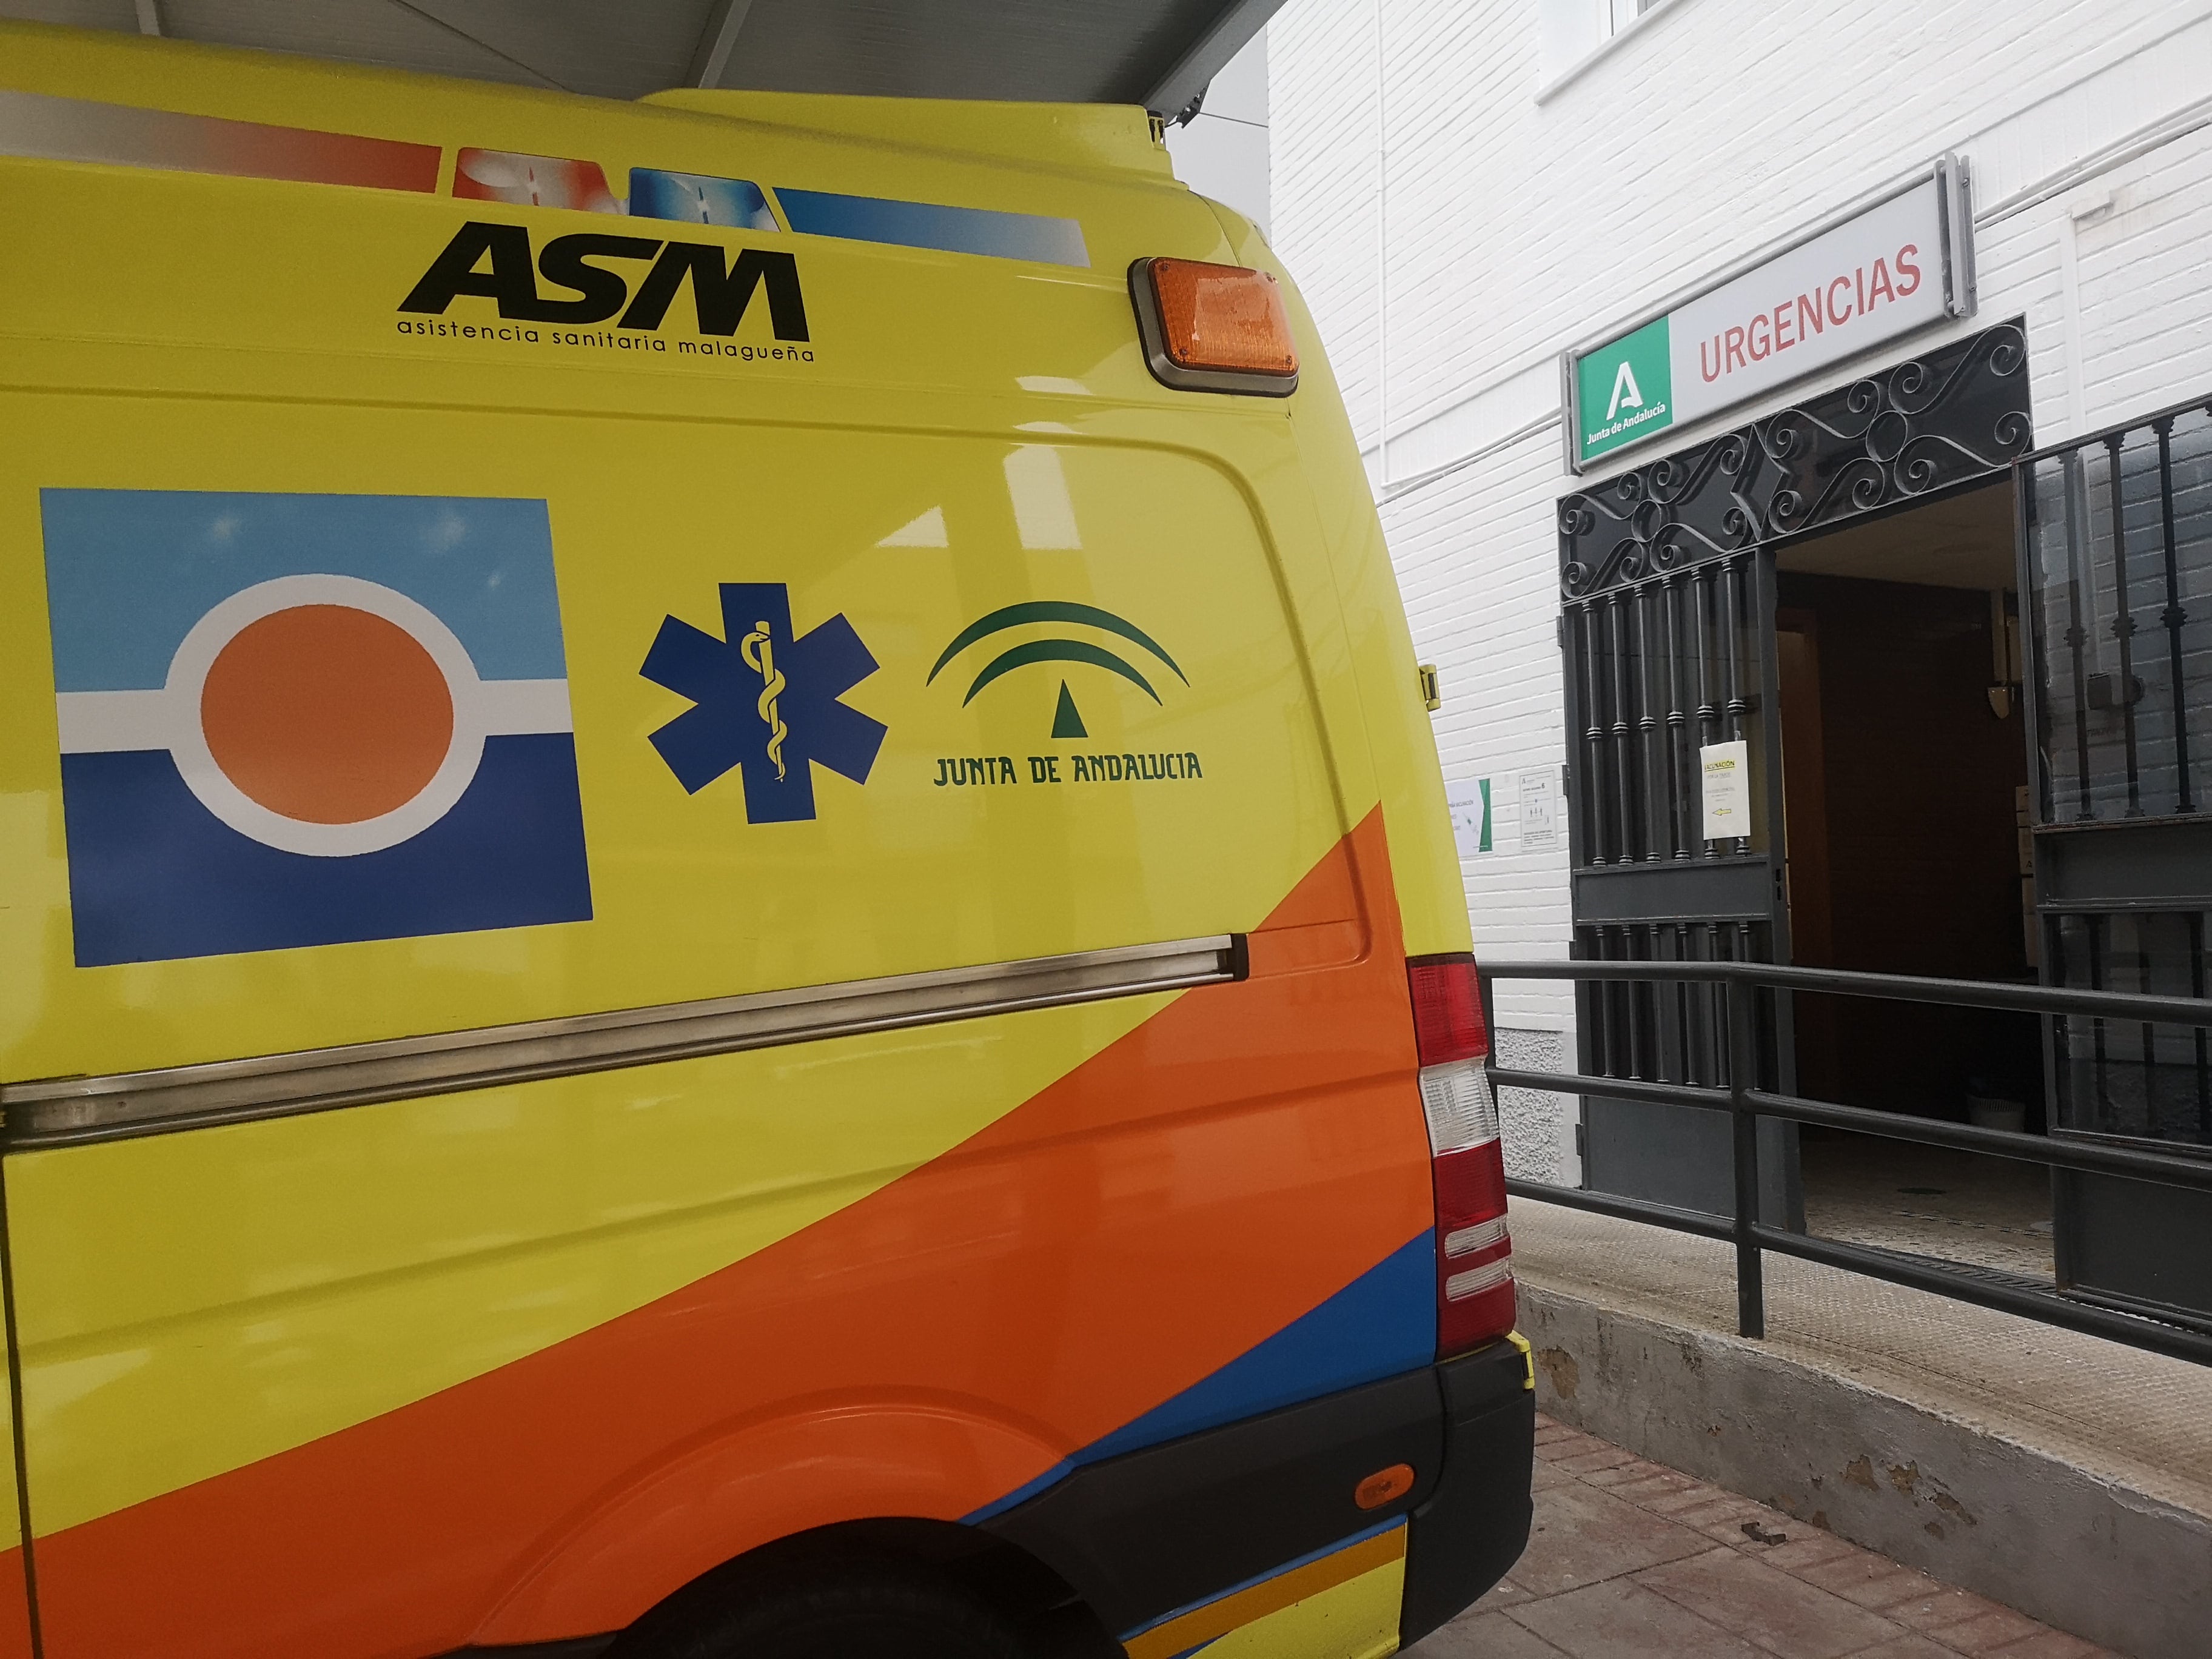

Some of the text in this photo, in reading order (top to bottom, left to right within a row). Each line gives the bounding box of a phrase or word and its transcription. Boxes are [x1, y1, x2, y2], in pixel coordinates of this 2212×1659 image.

[397, 221, 809, 343] ASM
[1700, 244, 1922, 383] URGENCIAS
[397, 320, 814, 363] asistencia sanitaria malagueña
[1586, 401, 1666, 445] Junta de Andalucía
[933, 752, 1203, 786] JUNTA DE ANDALUCIA
